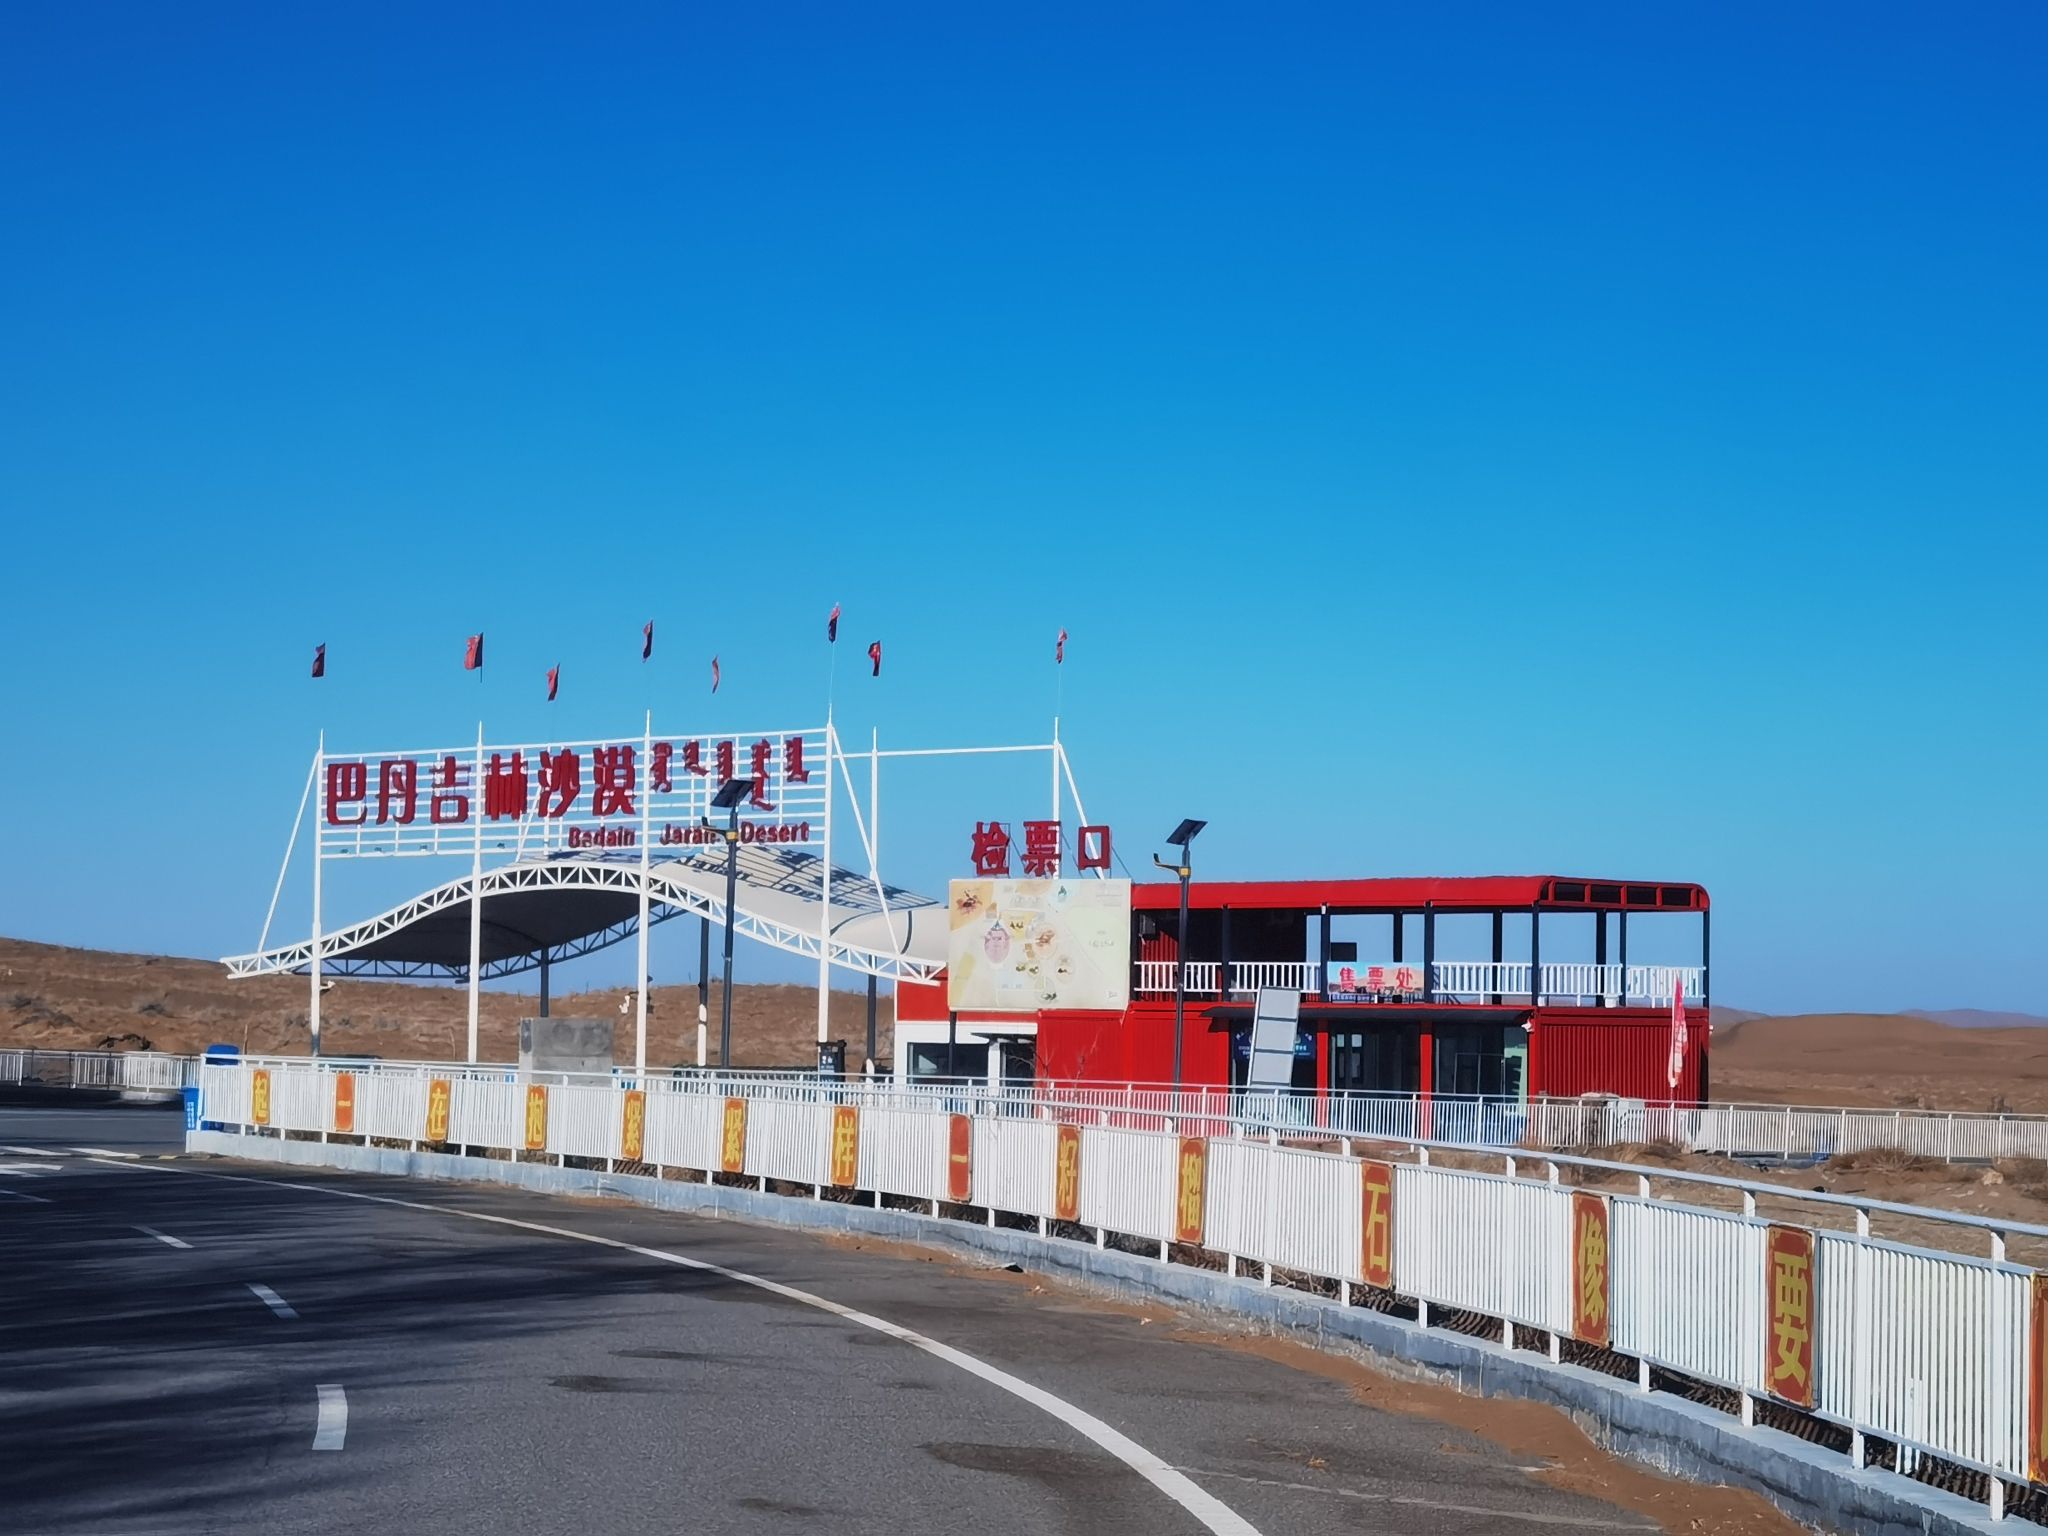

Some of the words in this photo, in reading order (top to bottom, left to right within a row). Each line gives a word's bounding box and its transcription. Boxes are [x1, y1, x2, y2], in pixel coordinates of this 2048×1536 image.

[325, 746, 637, 826] 巴丹吉林沙漠
[568, 827, 636, 848] Badain
[741, 821, 810, 843] Desert
[972, 820, 1112, 876] 检票口
[1339, 966, 1415, 992] 售票处
[254, 1076, 268, 1118] 起
[431, 1088, 448, 1134] 在
[528, 1092, 544, 1142] 抱
[626, 1100, 642, 1152] 紧
[725, 1108, 743, 1163] 紧
[833, 1115, 855, 1178] 样
[1059, 1135, 1078, 1210] 籽
[1180, 1152, 1201, 1231] 榴
[1365, 1181, 1390, 1272] 石
[1577, 1210, 1605, 1327] 像
[1772, 1251, 1811, 1387] 要
